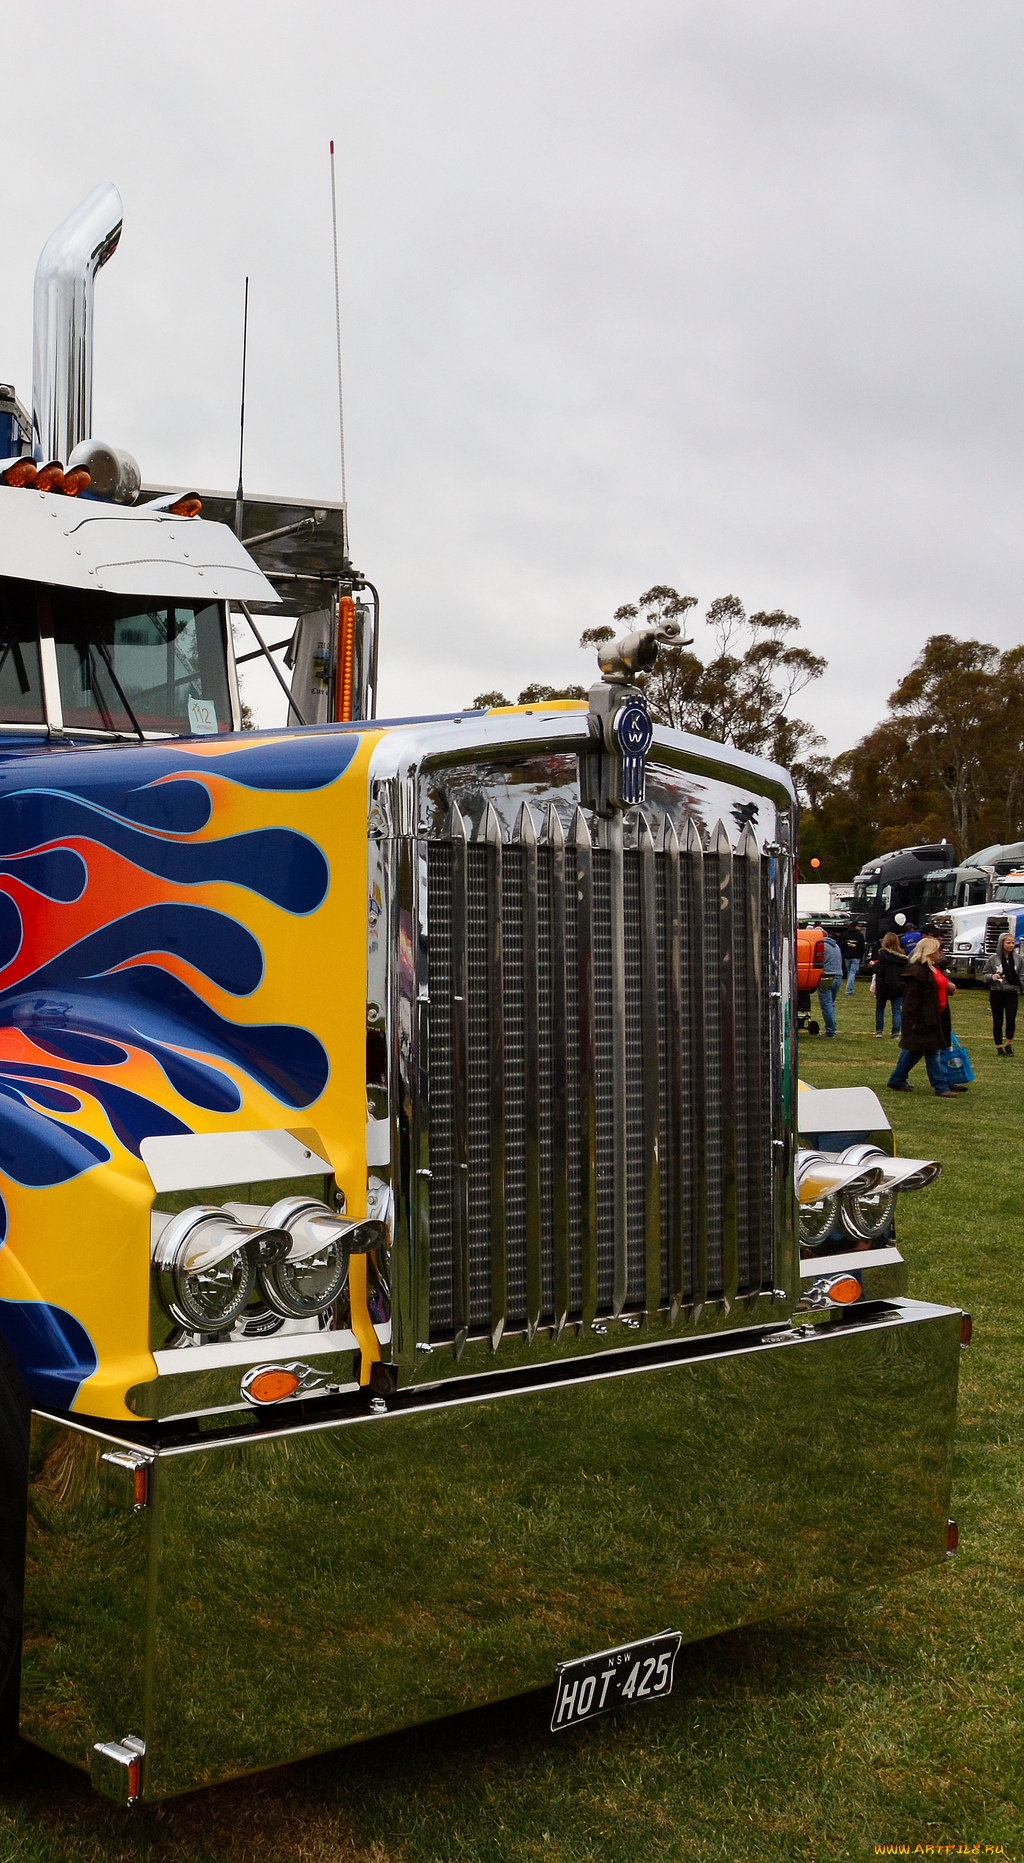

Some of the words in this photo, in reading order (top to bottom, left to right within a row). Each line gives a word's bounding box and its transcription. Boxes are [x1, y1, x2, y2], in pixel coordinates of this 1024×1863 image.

[608, 1652, 632, 1667] NSW
[557, 1669, 616, 1723] HOT
[621, 1652, 672, 1699] 425
